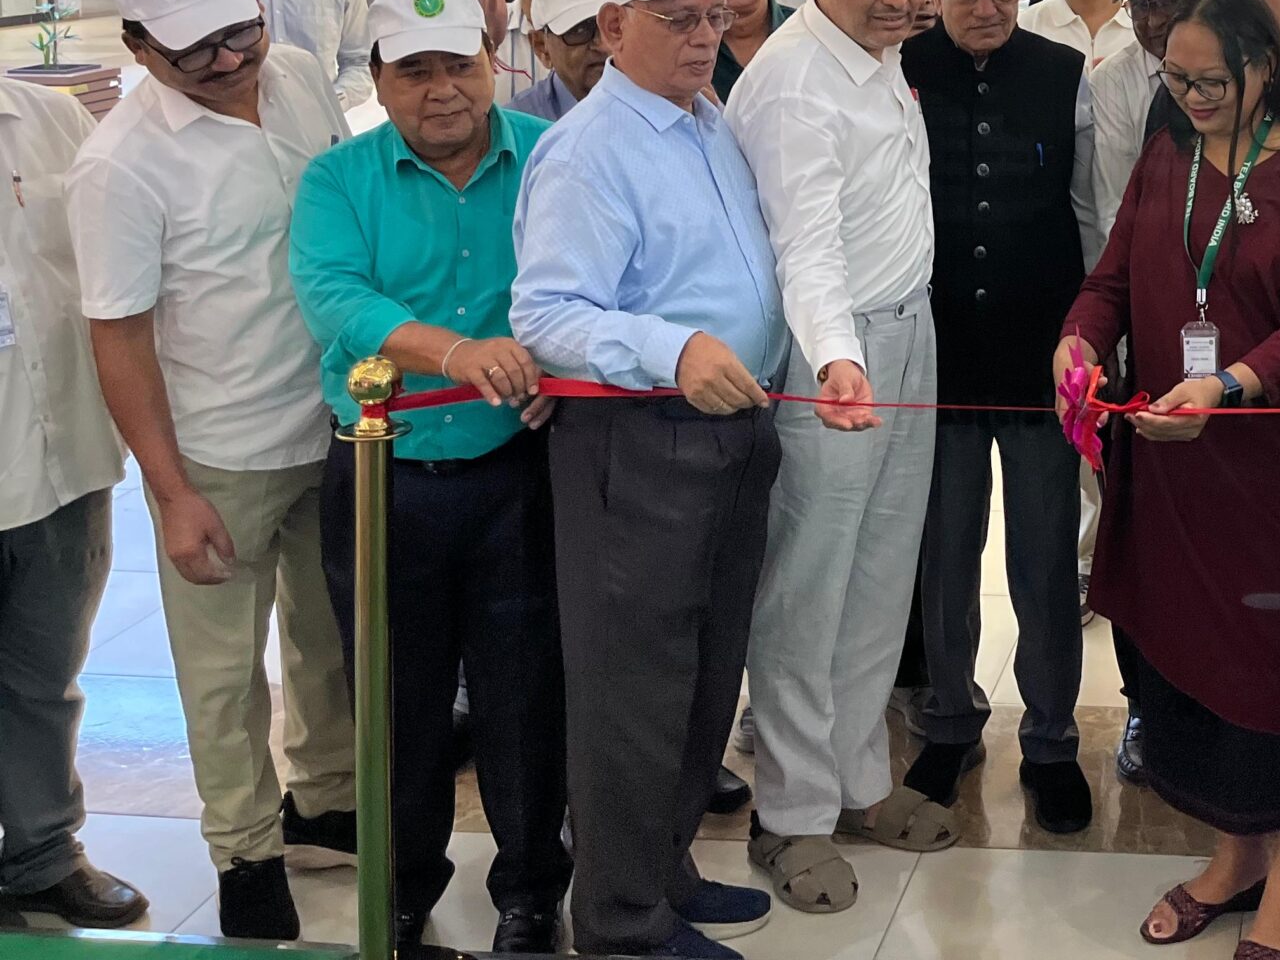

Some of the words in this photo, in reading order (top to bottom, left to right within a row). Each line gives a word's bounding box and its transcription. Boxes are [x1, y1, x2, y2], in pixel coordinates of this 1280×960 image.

[1188, 163, 1199, 198] BOARD
[1236, 161, 1252, 181] TEA
[1208, 217, 1226, 248] INDIA
